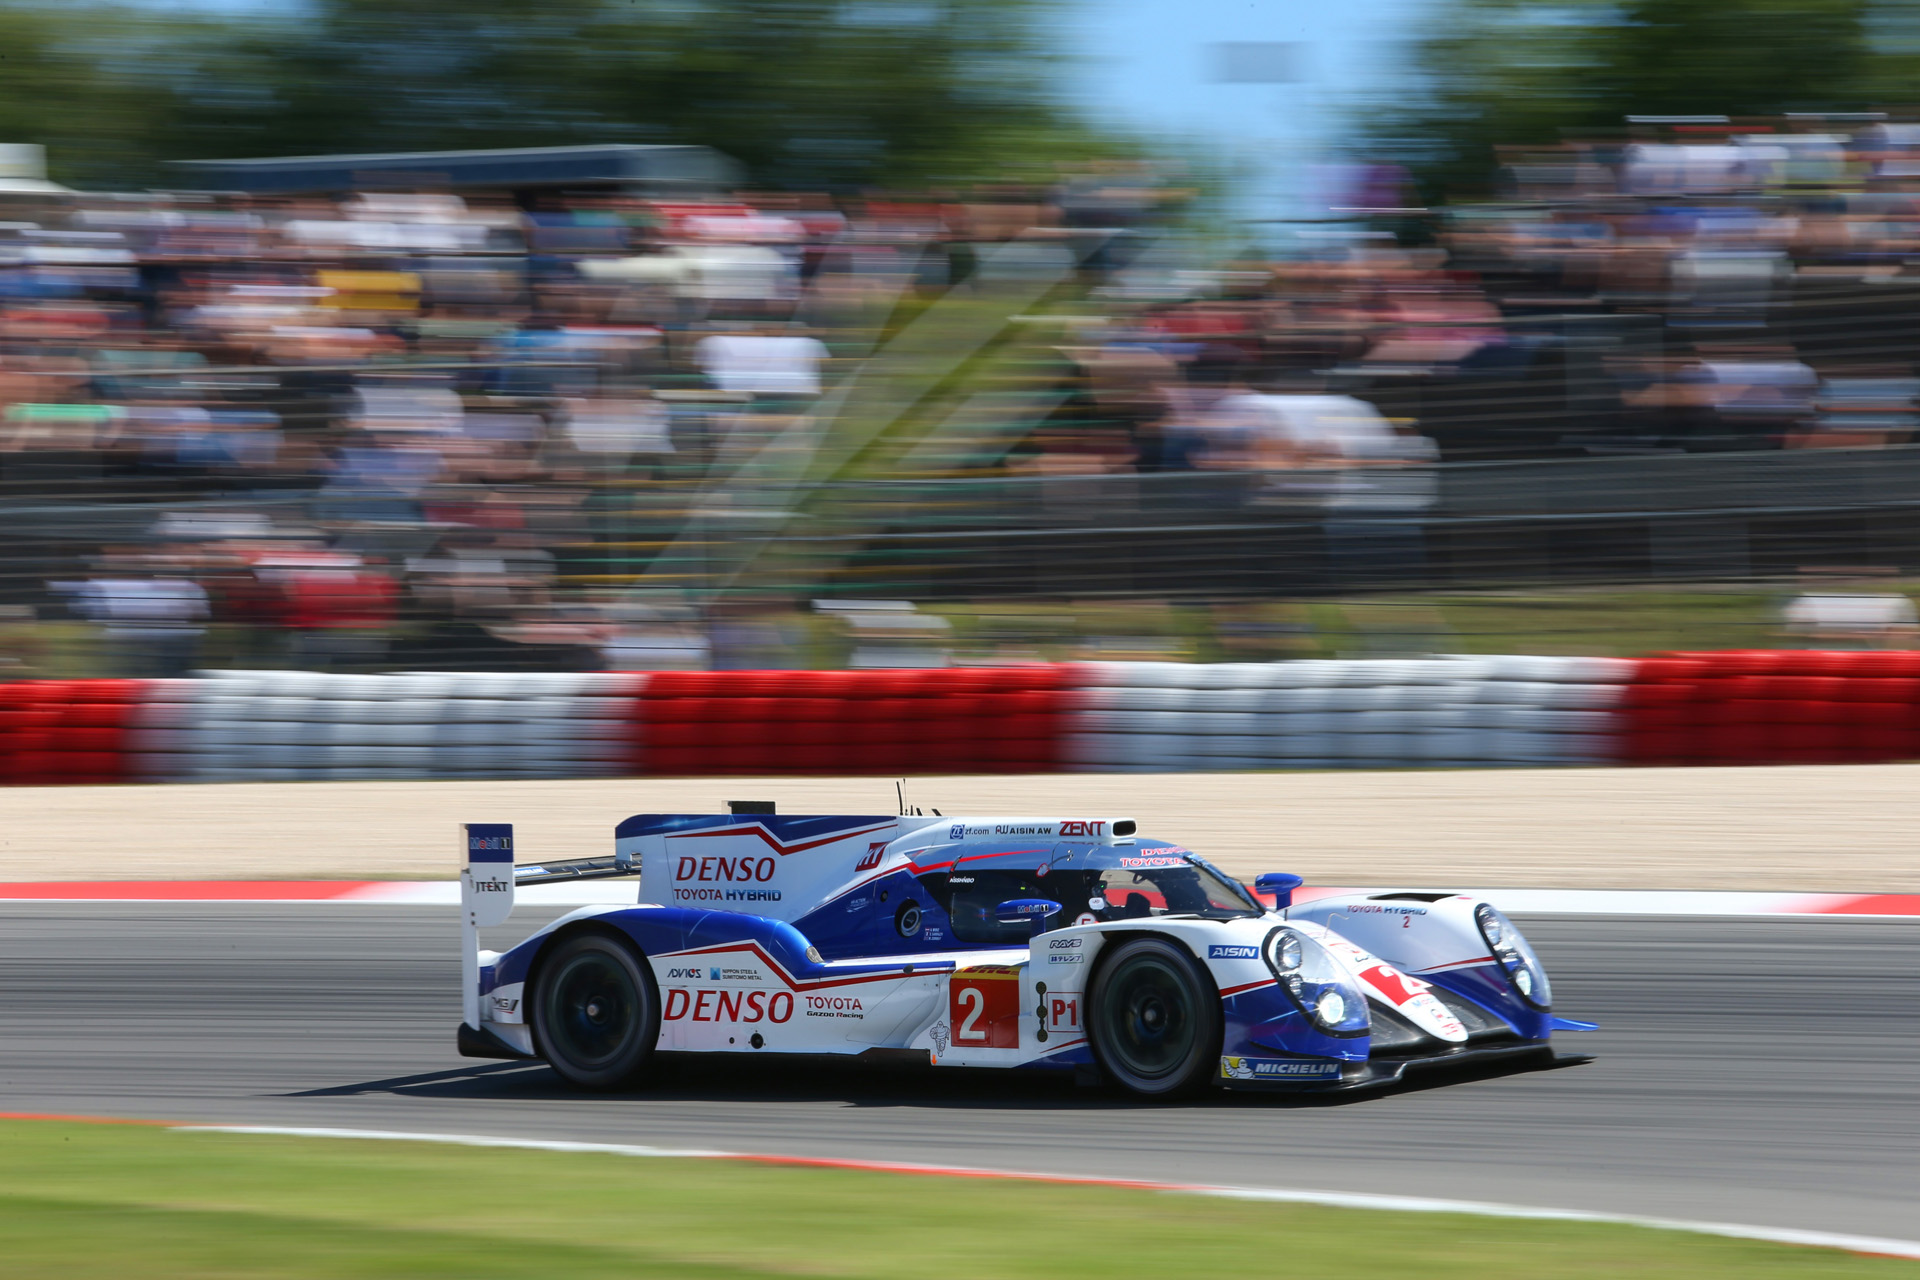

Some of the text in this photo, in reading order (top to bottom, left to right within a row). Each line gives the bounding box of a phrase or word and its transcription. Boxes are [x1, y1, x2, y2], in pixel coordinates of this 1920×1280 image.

[965, 827, 990, 836] zf.com
[1010, 827, 1035, 835] AISIN
[1037, 827, 1052, 835] AW
[1059, 821, 1106, 836] ZENT
[1120, 857, 1188, 867] TOYOTA
[676, 857, 775, 882] DENSO
[475, 881, 508, 893] JTEKT
[674, 888, 782, 901] TOYOTA HYBRID
[1347, 905, 1428, 916] TOYOTA HYBRID
[1402, 915, 1411, 928] 2
[1049, 939, 1082, 949] RAYS
[1211, 947, 1257, 958] AISIN
[667, 968, 702, 978] ADVICS
[663, 989, 794, 1024] DENSO
[805, 996, 863, 1010] TOYOTA
[836, 1012, 864, 1020] Racing
[958, 987, 986, 1040] 2
[1052, 999, 1077, 1026] P1
[1255, 1063, 1339, 1074] MICHELIN
